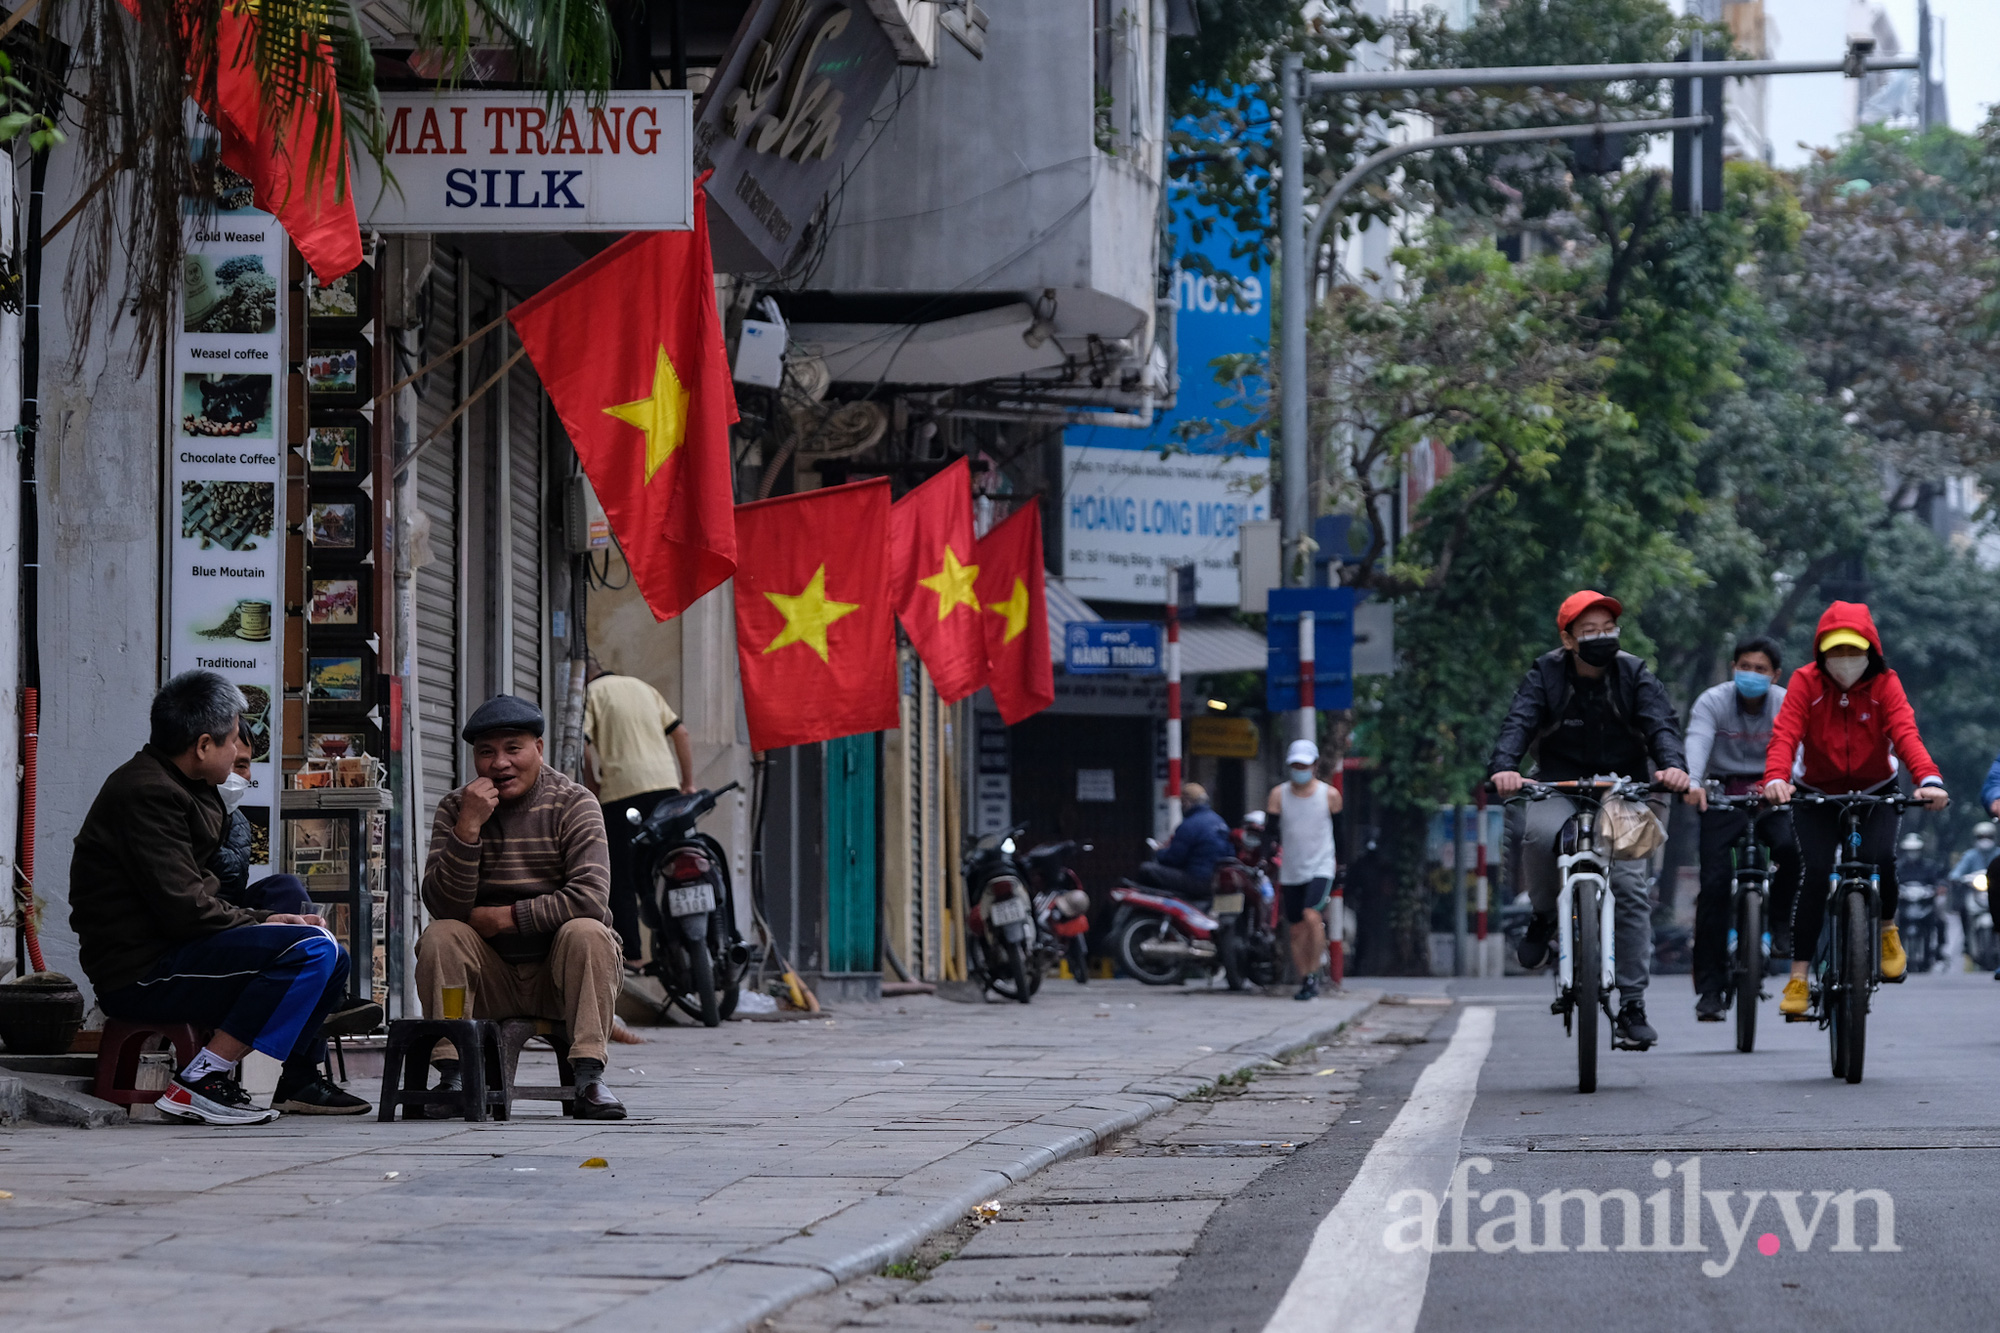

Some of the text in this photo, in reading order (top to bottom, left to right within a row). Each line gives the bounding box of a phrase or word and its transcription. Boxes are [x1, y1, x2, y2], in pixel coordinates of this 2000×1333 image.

[372, 107, 467, 154] MAI
[484, 107, 662, 155] TRANG
[445, 168, 584, 209] SILK
[195, 231, 265, 242] Gold Weasel
[190, 348, 269, 360] Weasel coffee
[180, 452, 276, 465] Chocolate Coffee
[1070, 485, 1136, 533] HOÀNG
[1140, 498, 1192, 536] LONG
[192, 565, 265, 578] Blue Moutain
[1072, 643, 1110, 666] HÀNG
[196, 657, 257, 669] Traditional
